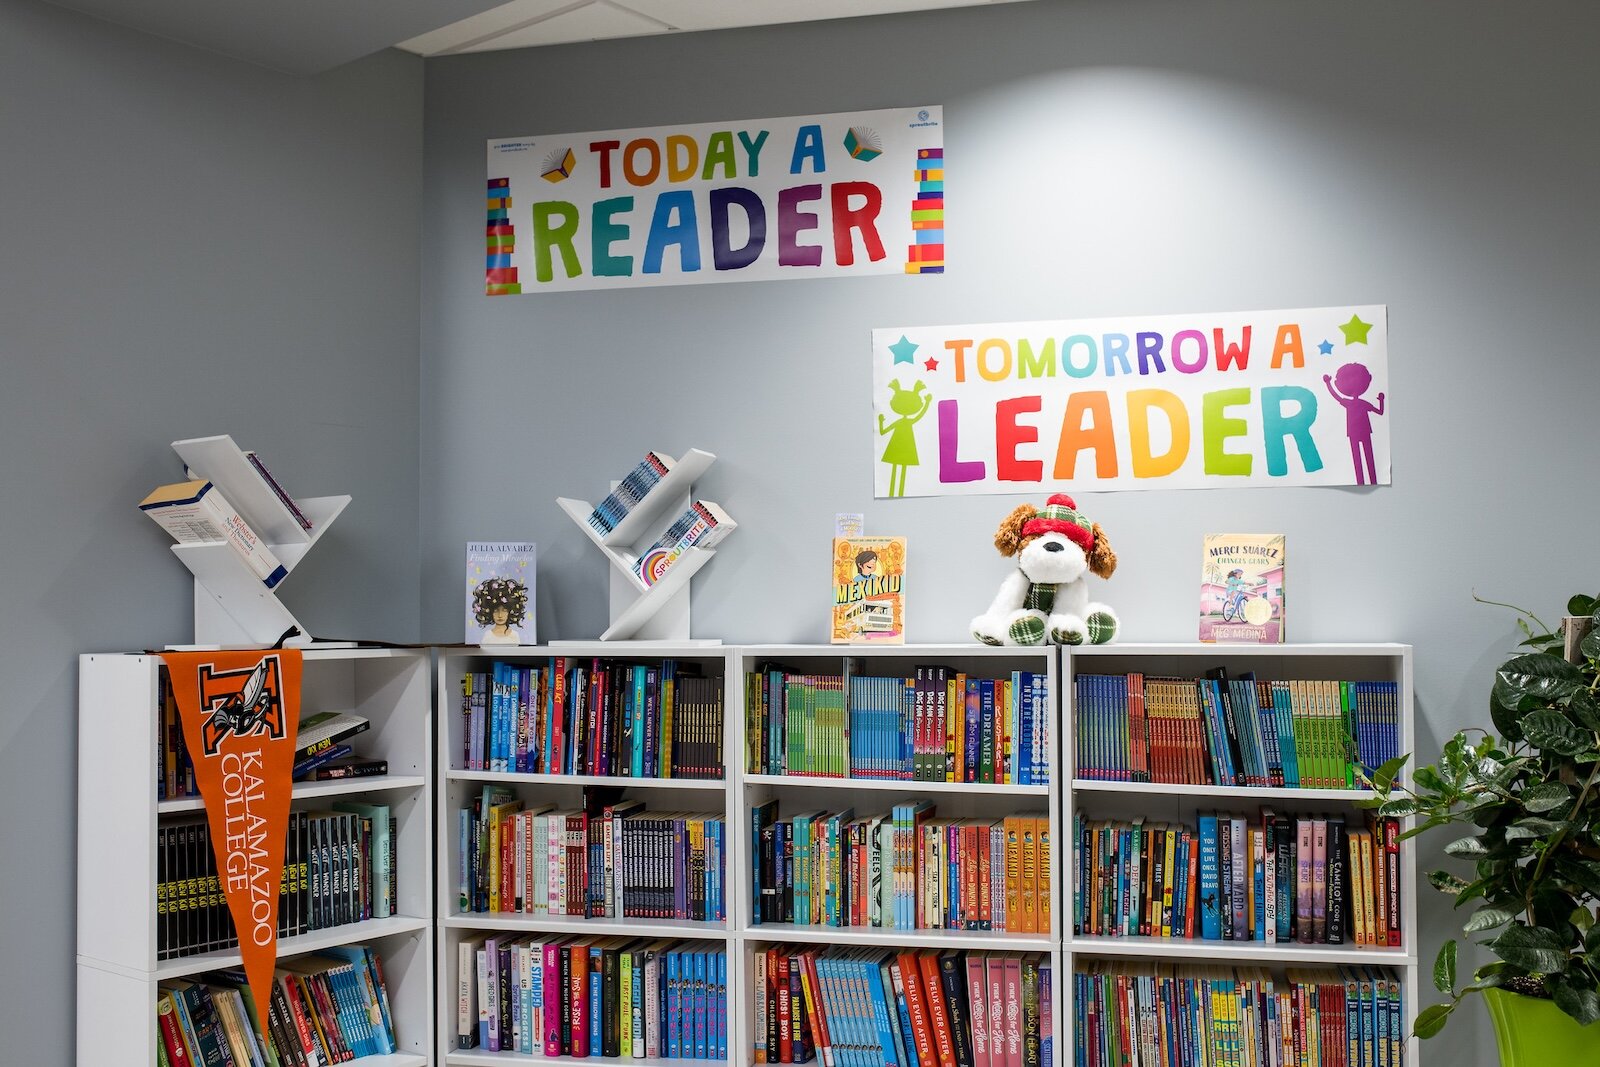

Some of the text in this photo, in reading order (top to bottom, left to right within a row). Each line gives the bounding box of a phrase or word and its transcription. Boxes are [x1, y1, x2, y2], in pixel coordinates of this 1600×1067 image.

[590, 125, 826, 188] TODAY A
[532, 181, 886, 282] READER
[945, 324, 1305, 382] TOMORROW A
[938, 385, 1324, 483] LEADER
[232, 514, 258, 545] Webster's
[1210, 545, 1239, 558] MERCI
[836, 574, 902, 604] MEXIKID
[1210, 628, 1267, 640] MEG MEDINA
[916, 691, 924, 704] DOG
[983, 714, 992, 765] DREAMER
[221, 753, 248, 893] COLLEGE
[242, 748, 272, 946] KALAMAZOO
[1007, 842, 1018, 878] MEXIKID
[1023, 842, 1034, 878] MEXIKID
[1040, 842, 1050, 878] MEXIKID
[289, 864, 297, 879] NEW
[1233, 852, 1243, 910] AFTERWARD
[1334, 862, 1342, 902] CAMELOT
[158, 883, 166, 914] NEW KID
[168, 882, 177, 912] NEW KID
[178, 880, 187, 910] NEW KID
[188, 879, 197, 909] NEW KID
[198, 877, 207, 907] NEW KID
[208, 876, 217, 906] NEW KID
[522, 979, 526, 988] US
[532, 967, 542, 1008] STAMPED
[278, 997, 290, 1024] ELIJAH
[294, 1000, 302, 1015] HOPE
[632, 968, 642, 1040] MAGGOT MOON
[792, 997, 800, 1021] PARADISE
[908, 980, 928, 1053] FELIX EVER AFTER
[929, 981, 949, 1055] FELIX EVER AFTER
[973, 998, 984, 1020] WORDS
[992, 1000, 1003, 1021] WORDS
[1007, 999, 1018, 1020] WORDS
[296, 1016, 306, 1033] NEVER
[1026, 1003, 1036, 1064] POISON HEART
[975, 1029, 987, 1053] Home
[993, 1030, 1005, 1054] Home
[1008, 1030, 1020, 1054] Home
[1214, 1022, 1222, 1067] RULES
